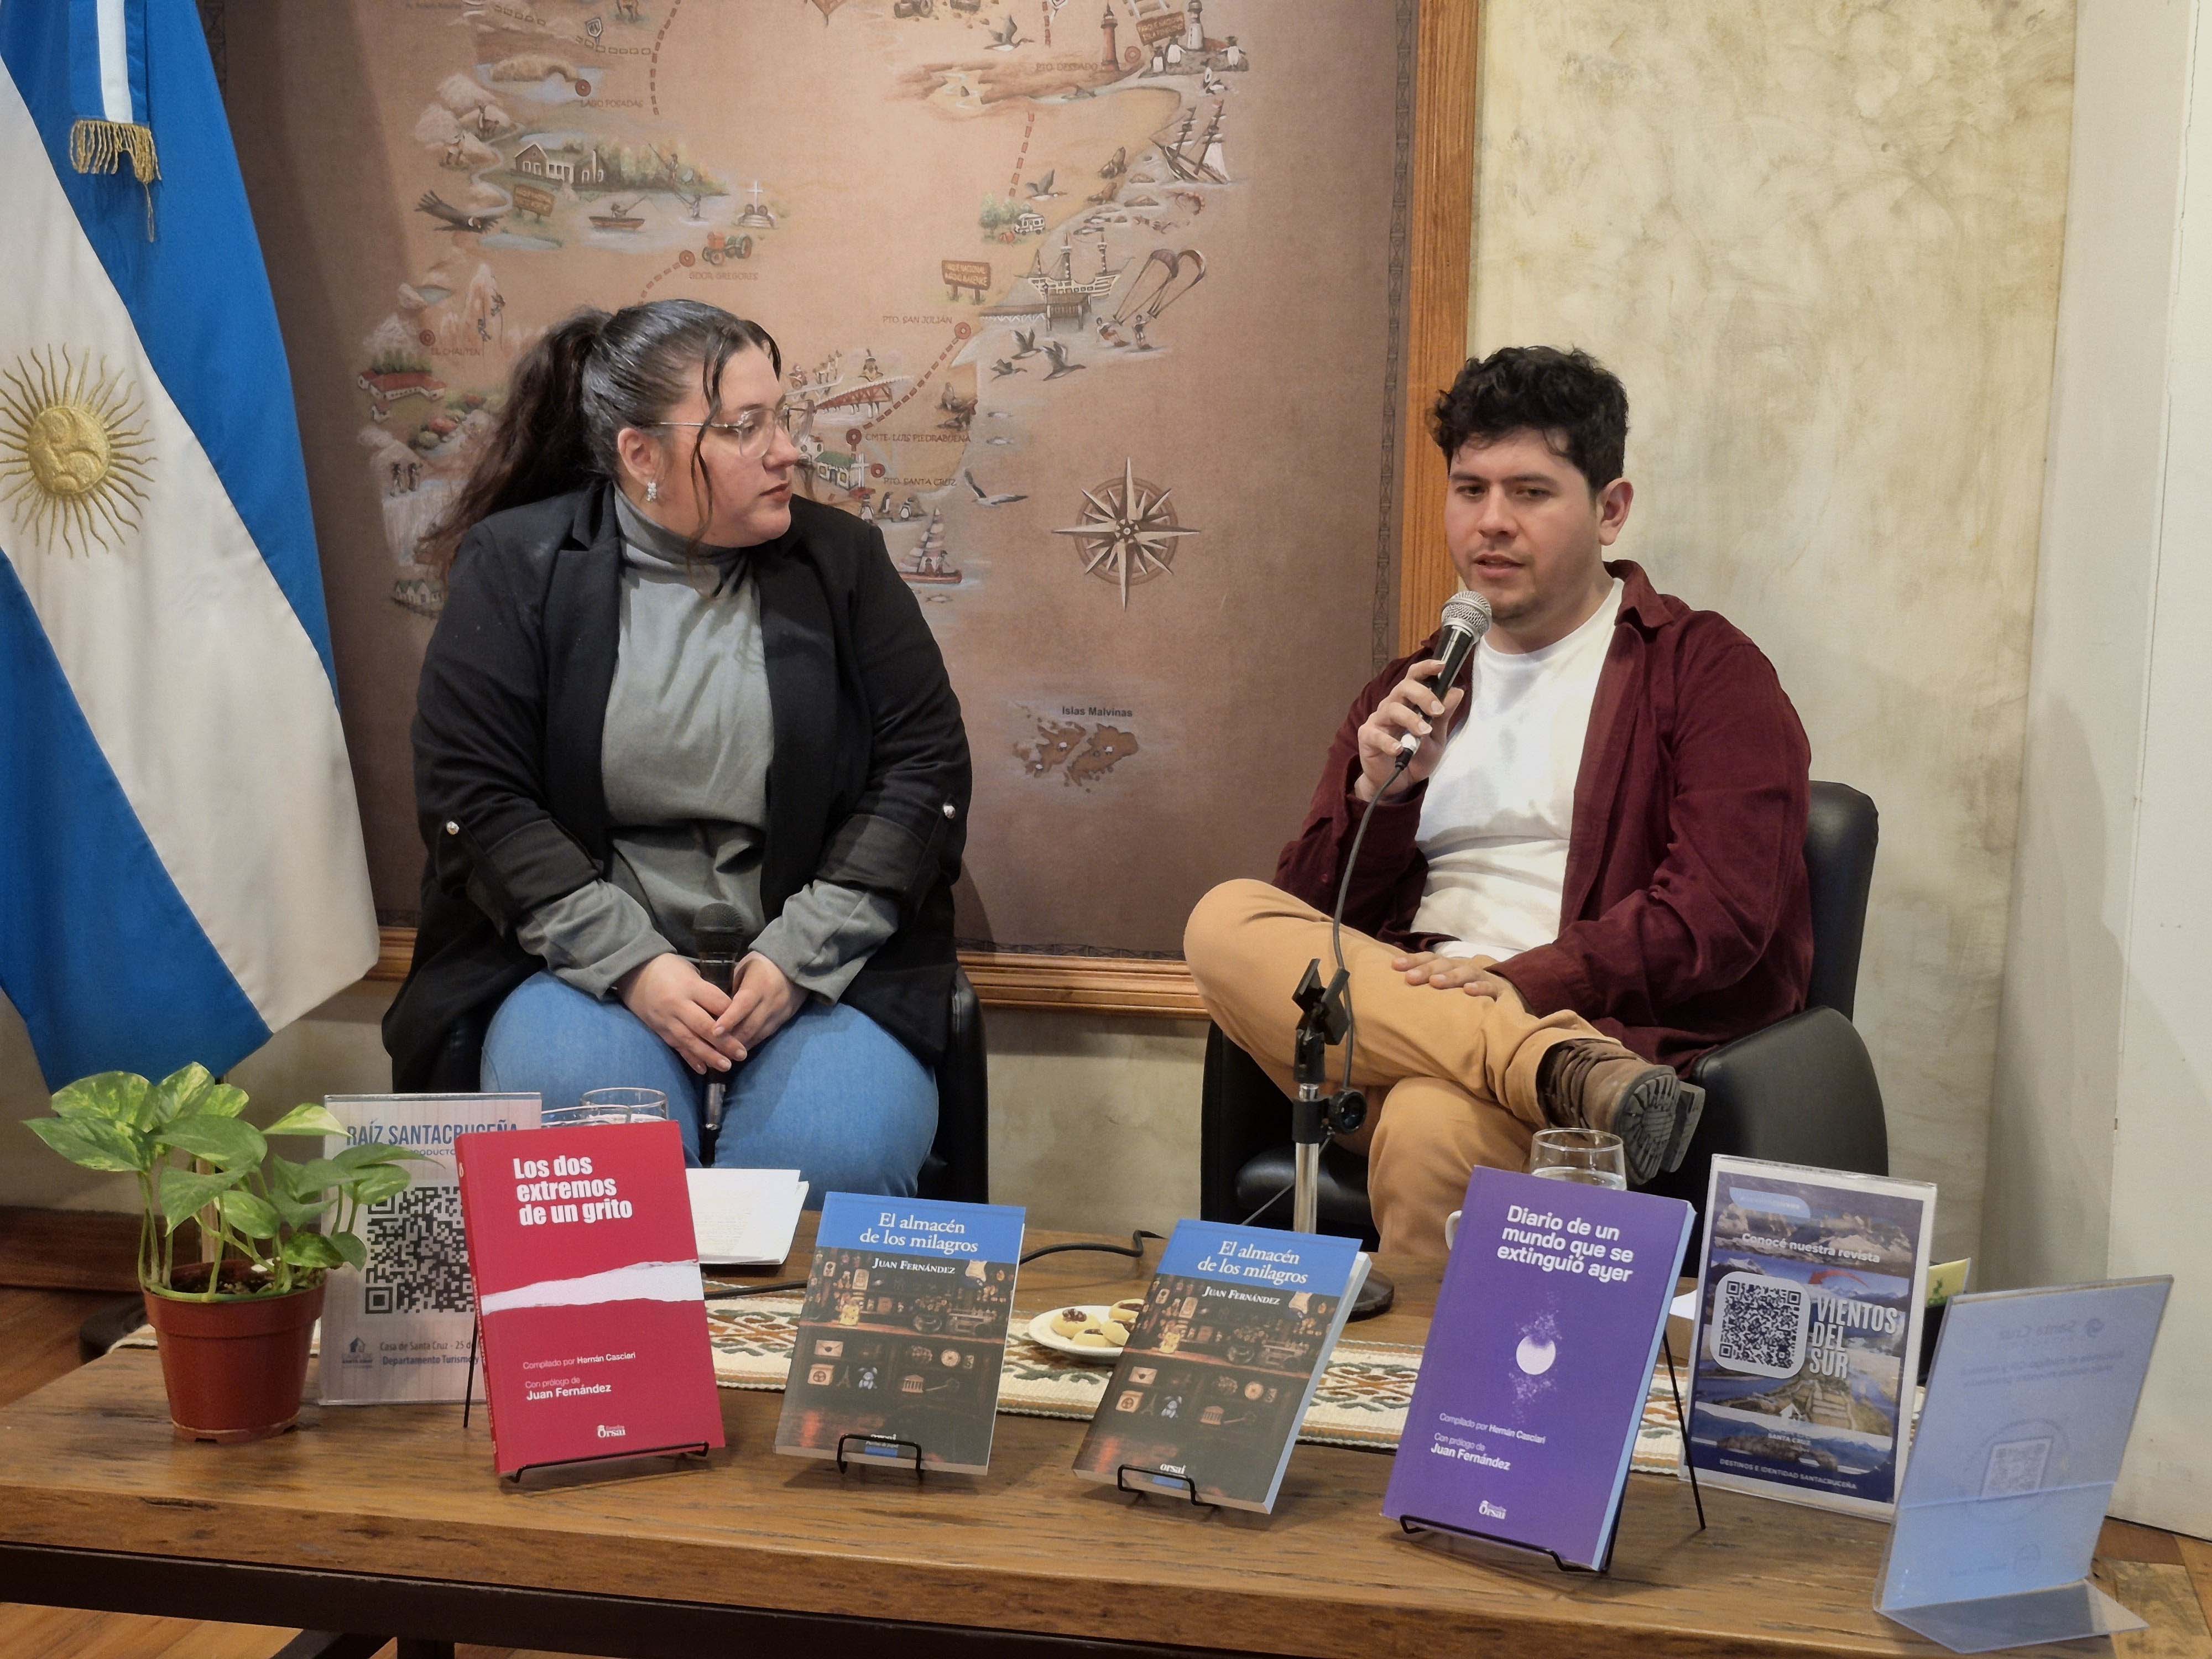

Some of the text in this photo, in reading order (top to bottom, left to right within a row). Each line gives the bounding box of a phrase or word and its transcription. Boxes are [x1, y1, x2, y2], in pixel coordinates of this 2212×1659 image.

[606, 100, 643, 108] POSADAS
[902, 316, 920, 324] SAN
[893, 434, 911, 442] LUIS
[913, 434, 971, 442] PIEDRABUENA
[933, 478, 957, 487] CRUZ
[1062, 706, 1133, 717] Islas Malvinas
[347, 1118, 383, 1146] RAÍZ
[513, 1155, 593, 1179] Los dos
[517, 1178, 617, 1202] extremos
[519, 1198, 633, 1226] de un grito
[878, 1212, 965, 1234] El almacén
[1507, 1204, 1621, 1241] Diario de un
[859, 1227, 979, 1255] de los milagros
[1218, 1240, 1301, 1265] El almacén
[1501, 1227, 1634, 1264] mundo que se
[1741, 1233, 1880, 1263] Conocé nuestra revista
[1197, 1256, 1308, 1286] de los milagros
[1496, 1244, 1634, 1284] extinguió ayer
[1817, 1296, 1898, 1334] VIENTOS
[380, 1342, 396, 1351] Casa
[398, 1342, 408, 1350] de
[410, 1341, 431, 1350] Santa
[432, 1341, 448, 1350] Cruz
[455, 1340, 464, 1349] 25
[1812, 1321, 1846, 1353] DEL
[383, 1355, 441, 1367] Departamento
[523, 1352, 635, 1370] Compilado por Hernán Casciari
[1809, 1348, 1848, 1379] SUR
[525, 1376, 581, 1389] Con prólogo de
[526, 1384, 612, 1401] Juan Fernández
[1439, 1412, 1547, 1444] Compilado por Hernán Casciari
[1434, 1432, 1486, 1452] Con prólogo de
[1431, 1442, 1511, 1471] Juan Fernández
[1719, 1458, 1754, 1471] DESTINOS
[1760, 1465, 1799, 1479] IDENTIDAD
[1800, 1472, 1858, 1490] SANTACRUCEÑA
